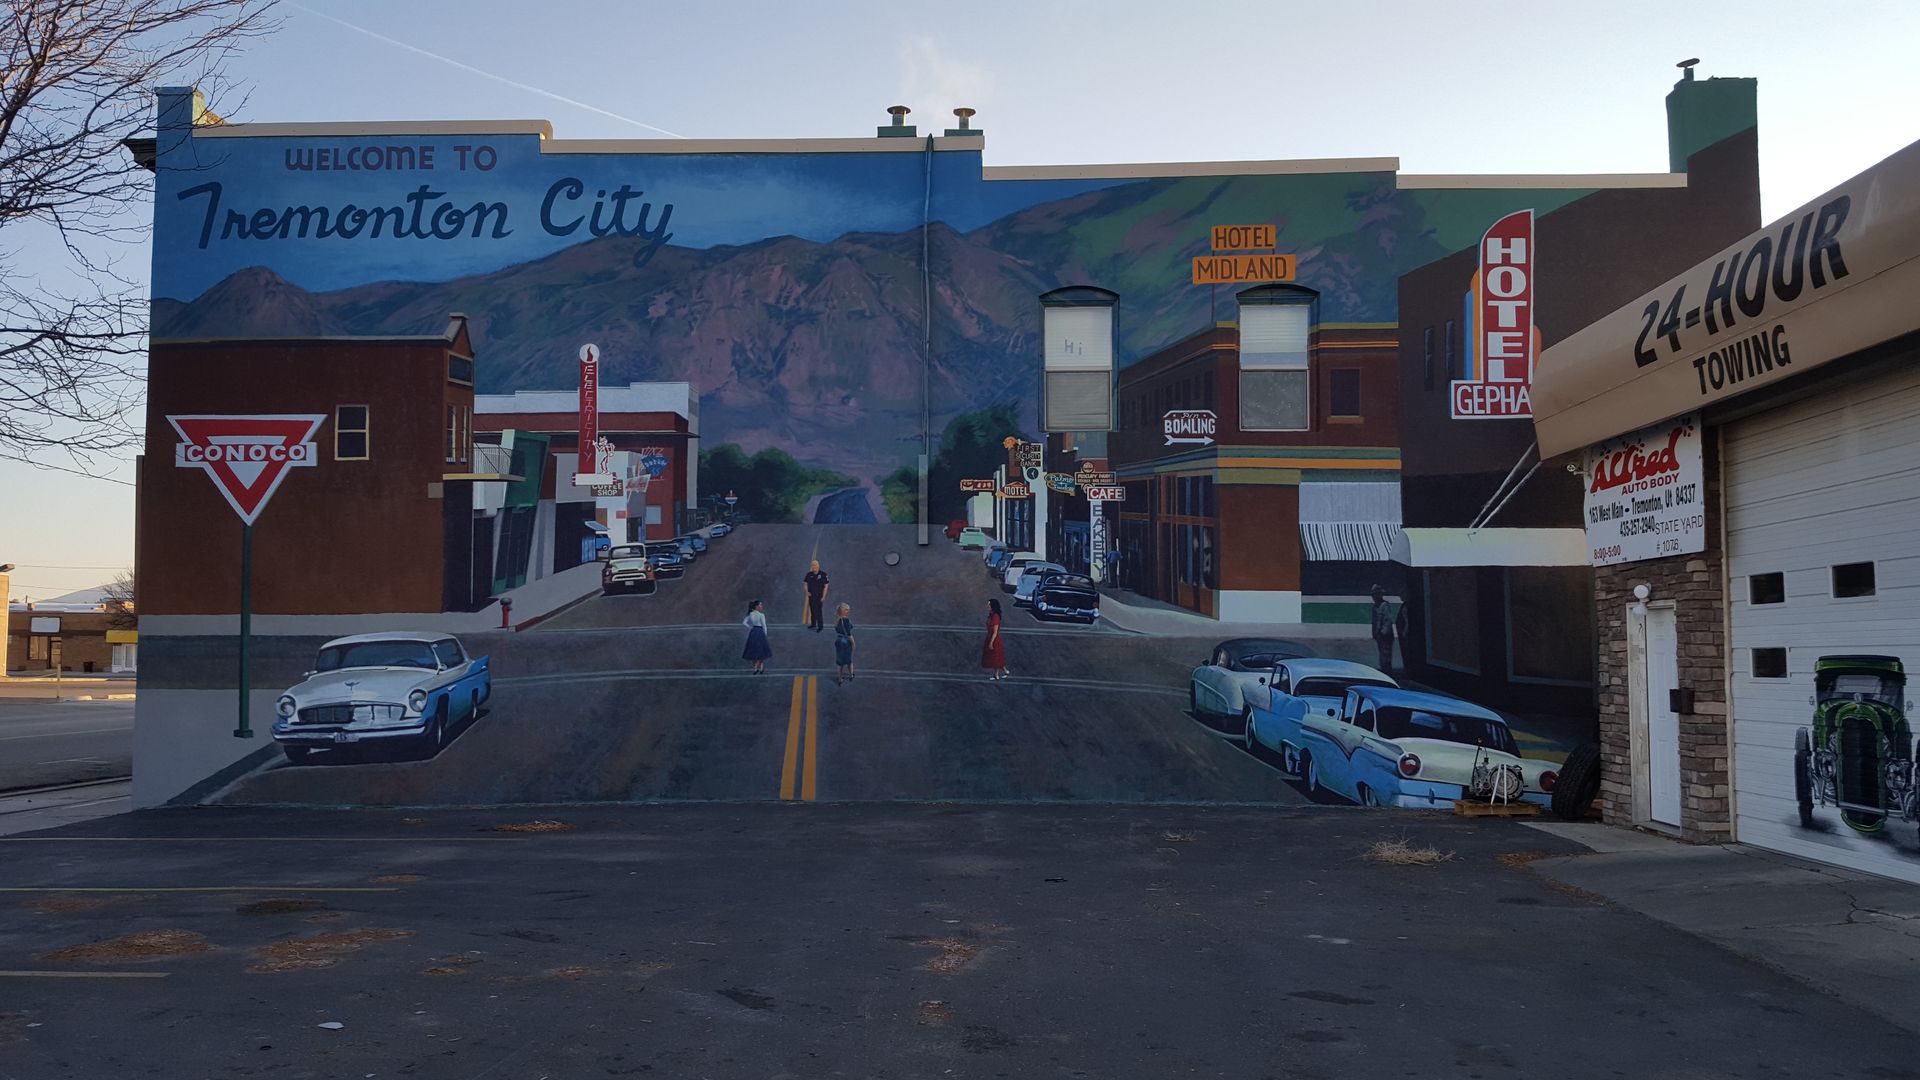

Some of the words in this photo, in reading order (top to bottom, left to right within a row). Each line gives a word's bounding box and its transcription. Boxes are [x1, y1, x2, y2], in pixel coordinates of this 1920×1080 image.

[286, 145, 434, 171] WELCOME
[453, 145, 497, 171] TO
[177, 180, 513, 249] Tremonton
[540, 177, 673, 267] City
[1215, 226, 1273, 249] HOTEL
[1197, 257, 1288, 281] MIDLAND
[1634, 195, 1852, 368] 24-HOUR
[1486, 237, 1528, 383] HOTEL
[1064, 339, 1083, 356] Hi
[1692, 324, 1792, 396] TOWING
[1164, 418, 1216, 434] BOWLING
[186, 444, 306, 461] CONOCO
[597, 489, 618, 497] SHOP
[1090, 488, 1123, 499] CAFE
[1621, 480, 1648, 495] AUTO
[1650, 472, 1680, 488] BODY
[1612, 501, 1624, 519] Main
[1655, 519, 1680, 535] STATE
[1681, 514, 1704, 530] YARD
